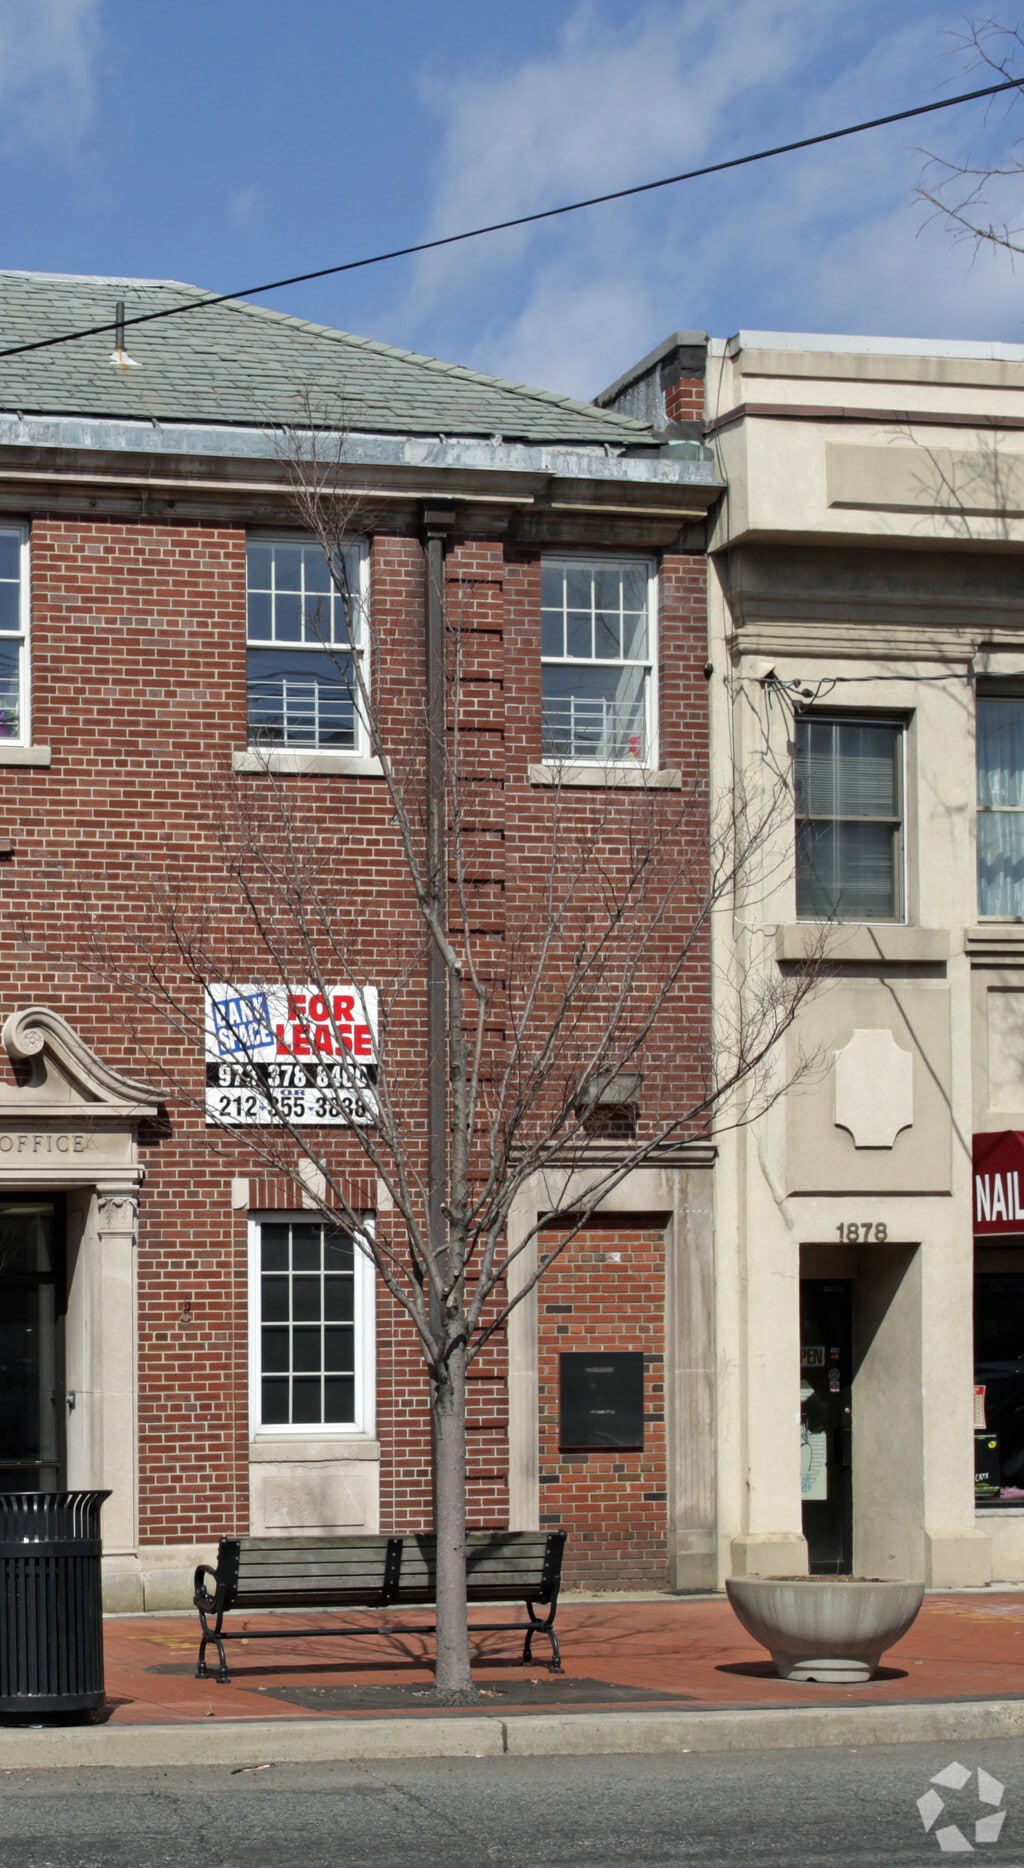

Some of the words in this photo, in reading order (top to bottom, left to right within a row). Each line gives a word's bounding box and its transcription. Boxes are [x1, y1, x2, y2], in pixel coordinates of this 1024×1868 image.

[215, 996, 266, 1027] BANK
[287, 994, 355, 1021] FOR
[219, 1020, 272, 1051] SPACE
[276, 1024, 372, 1056] LEASE
[280, 1088, 305, 1096] OR
[976, 1171, 1024, 1222] NAIL
[836, 1222, 888, 1243] 1878
[800, 1348, 823, 1364] PEN
